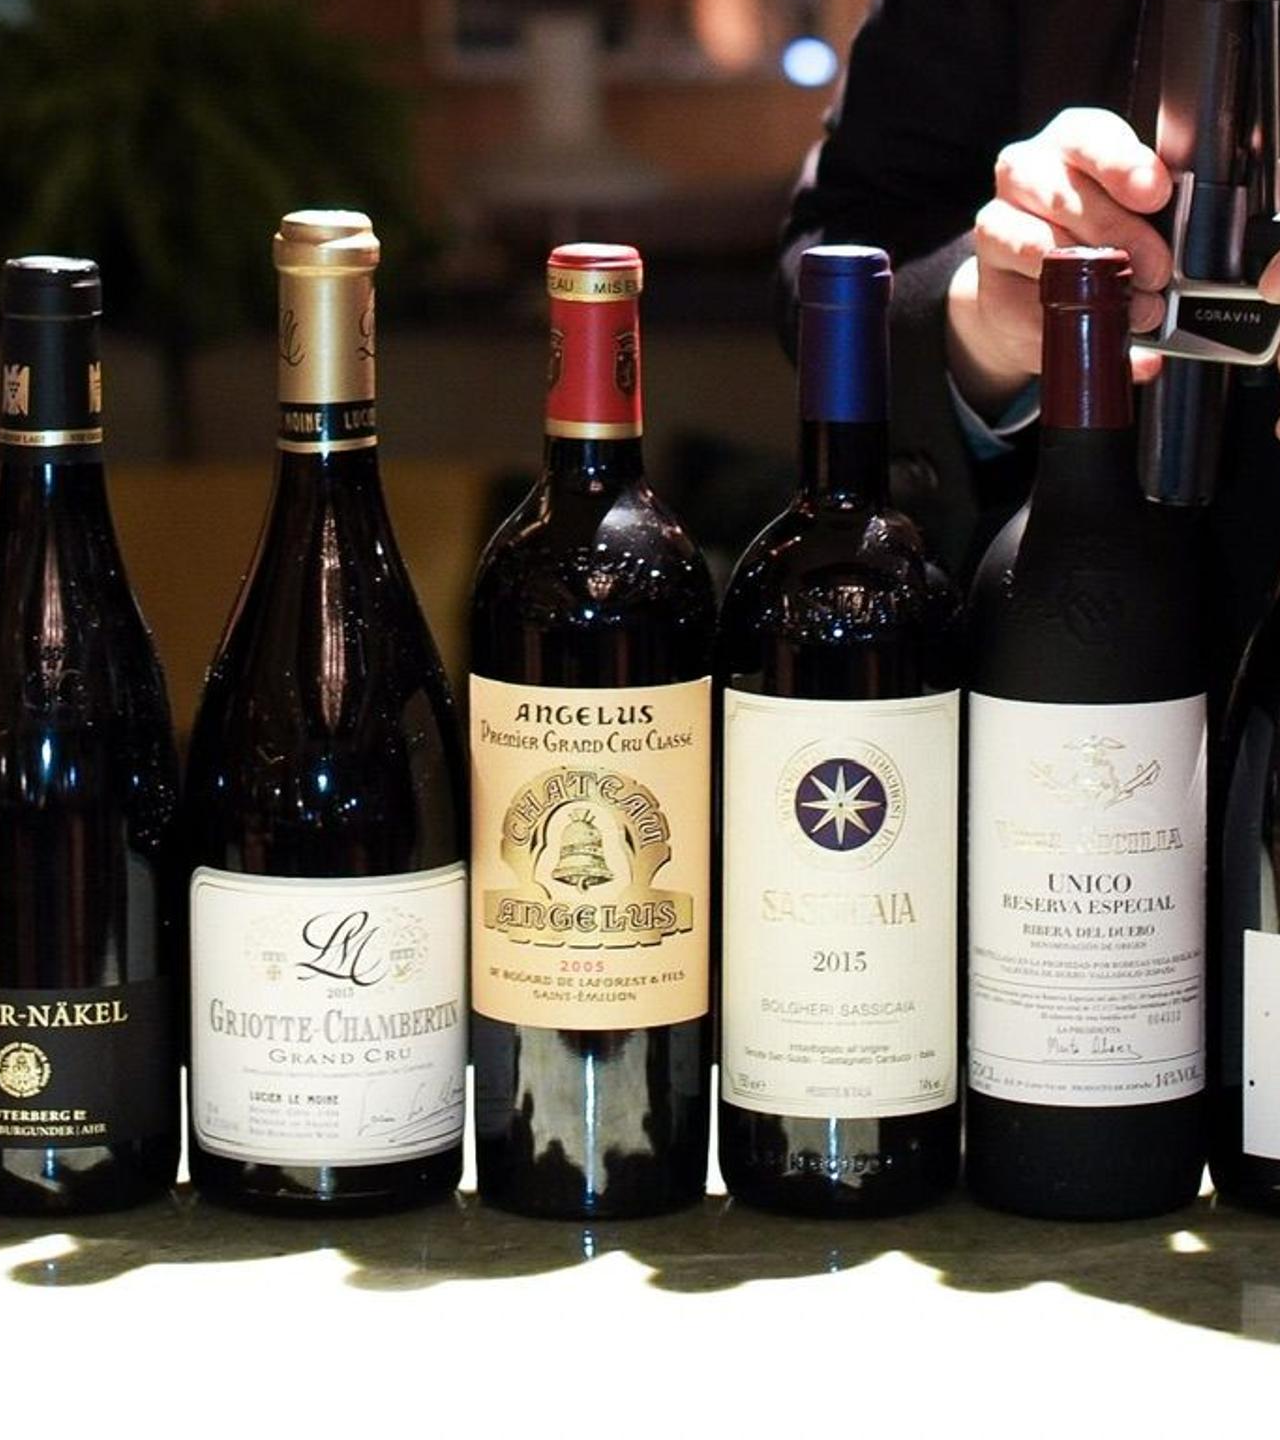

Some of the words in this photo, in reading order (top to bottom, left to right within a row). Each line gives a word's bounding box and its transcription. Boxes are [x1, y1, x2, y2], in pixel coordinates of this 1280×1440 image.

[1194, 308, 1261, 323] CORAVIN
[514, 703, 653, 726] ANGELUS
[607, 732, 642, 753] CRU
[1048, 873, 1133, 895] UNICO
[1002, 893, 1083, 914] RESERVA
[1088, 895, 1176, 915] ESPECIAL
[497, 898, 678, 933] ANGELUS
[1021, 923, 1072, 938] RIBERA
[1075, 926, 1106, 939] DEL
[1108, 925, 1156, 939] DUERO
[559, 960, 606, 973] 2005
[812, 951, 868, 972] 2015
[268, 1048, 354, 1064] GRAND
[364, 1048, 412, 1064] CRU
